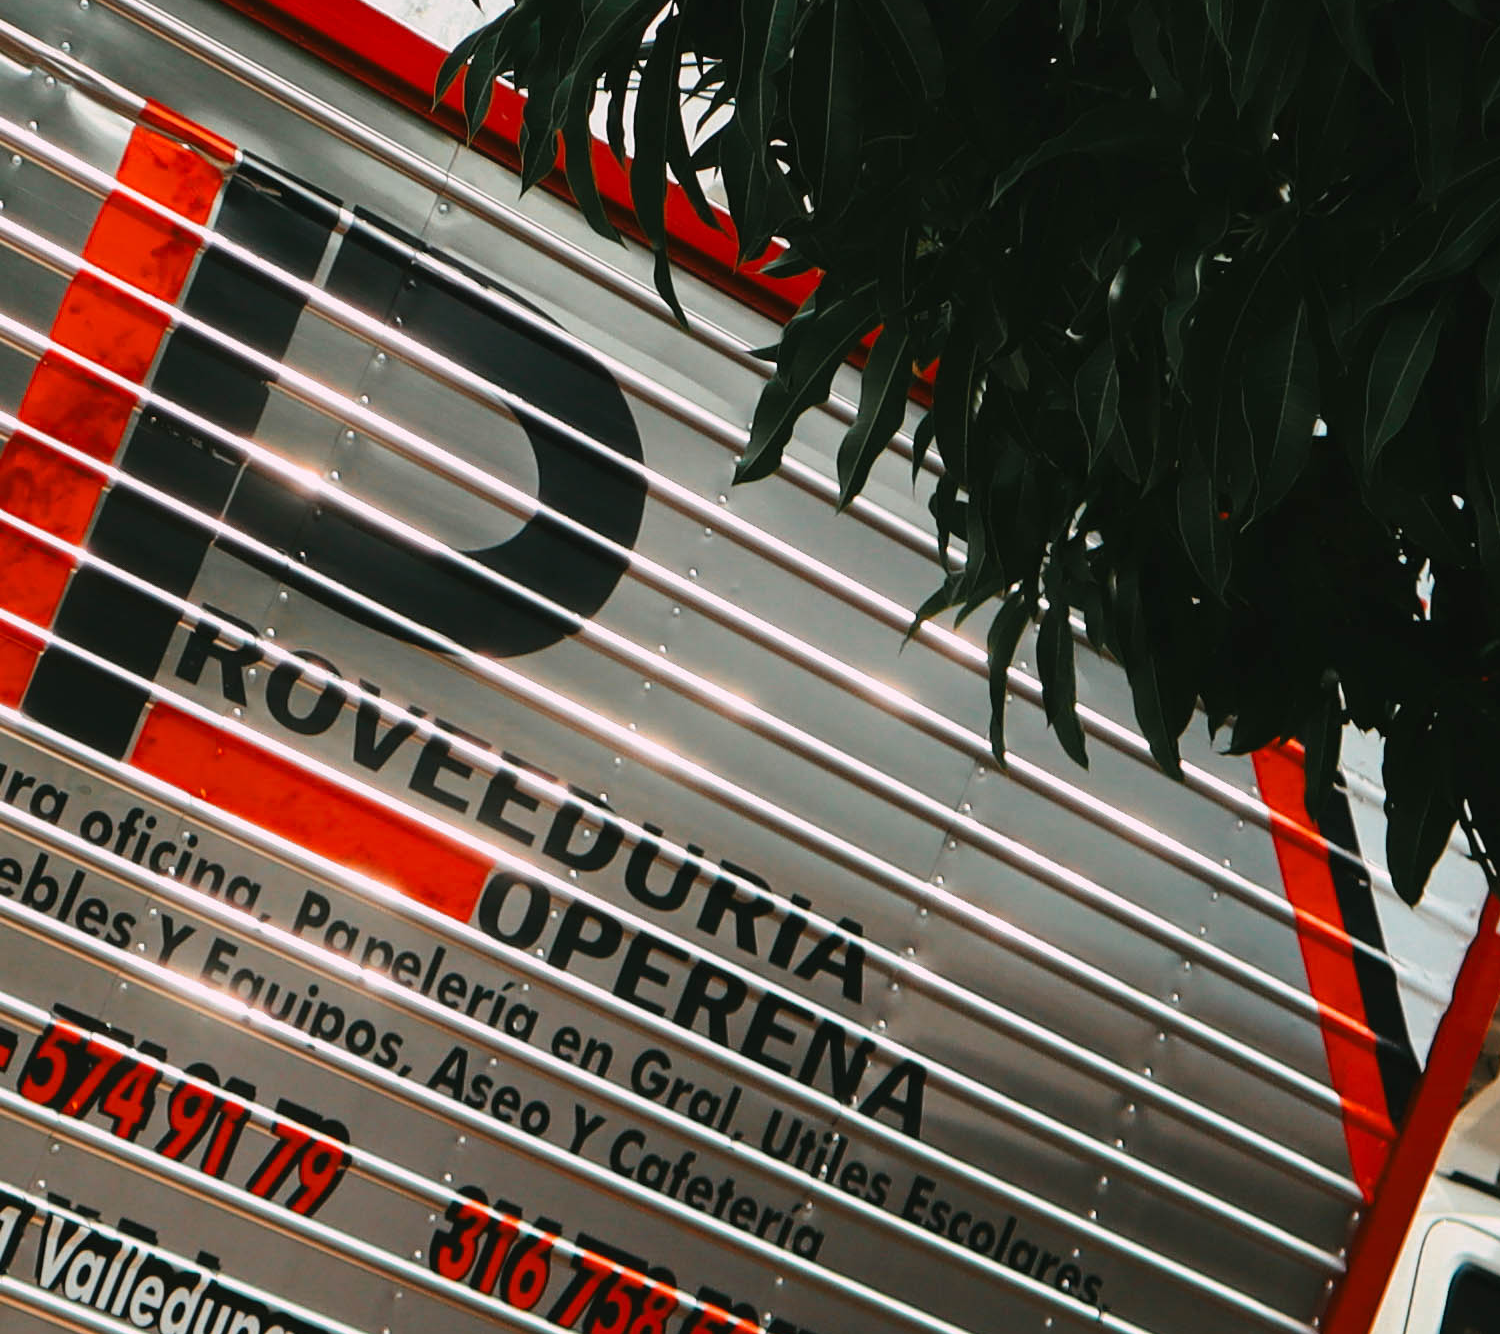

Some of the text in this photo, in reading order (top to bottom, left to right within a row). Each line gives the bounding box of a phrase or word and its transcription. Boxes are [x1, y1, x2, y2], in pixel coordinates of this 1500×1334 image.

[174, 606, 871, 1003] ROVEEDURIA
[158, 915, 197, 966] Y
[431, 1046, 550, 1136] Aseo
[571, 1105, 610, 1154] Y
[608, 1128, 824, 1262] Cafetería
[294, 890, 539, 1042] Papelería
[553, 1016, 613, 1068] en
[477, 871, 929, 1143] OPERENA
[18, 1017, 159, 1139] 574
[169, 1076, 248, 1177] 91
[253, 1123, 347, 1215] 79
[437, 1197, 560, 1311] 316
